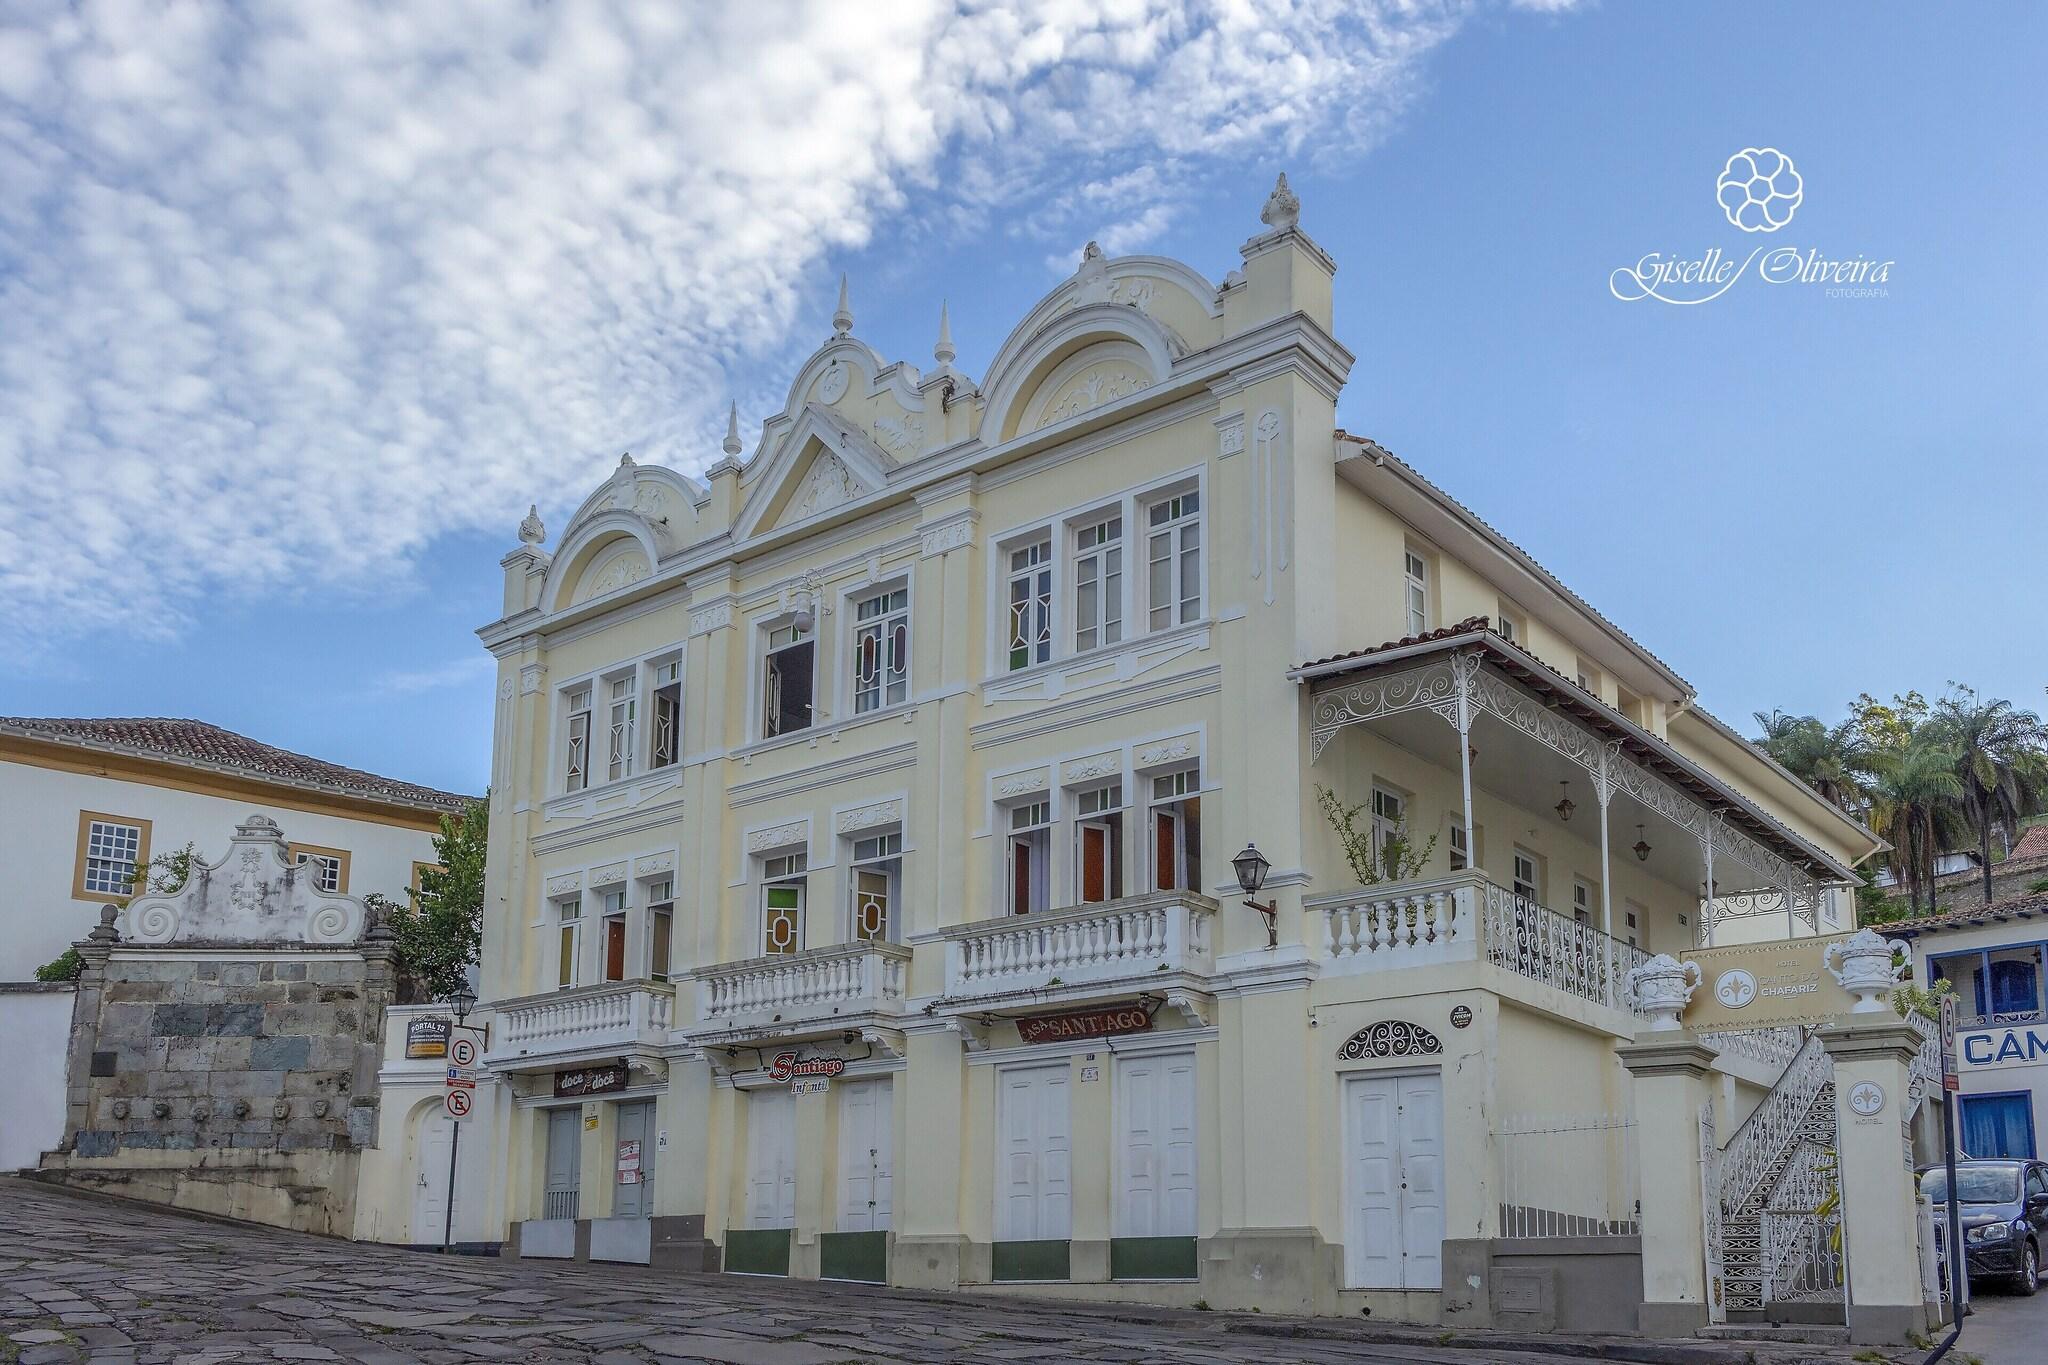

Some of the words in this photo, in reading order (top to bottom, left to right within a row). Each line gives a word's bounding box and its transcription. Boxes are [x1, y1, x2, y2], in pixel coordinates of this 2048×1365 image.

[1761, 984, 1818, 996] CHAFARIZ
[410, 1022, 436, 1032] PORTAL
[436, 1024, 446, 1032] 13
[1049, 1011, 1147, 1036] SANTIAGO
[768, 1050, 844, 1083] Santiago
[561, 1073, 584, 1088] doce
[792, 1080, 829, 1096] Infantil
